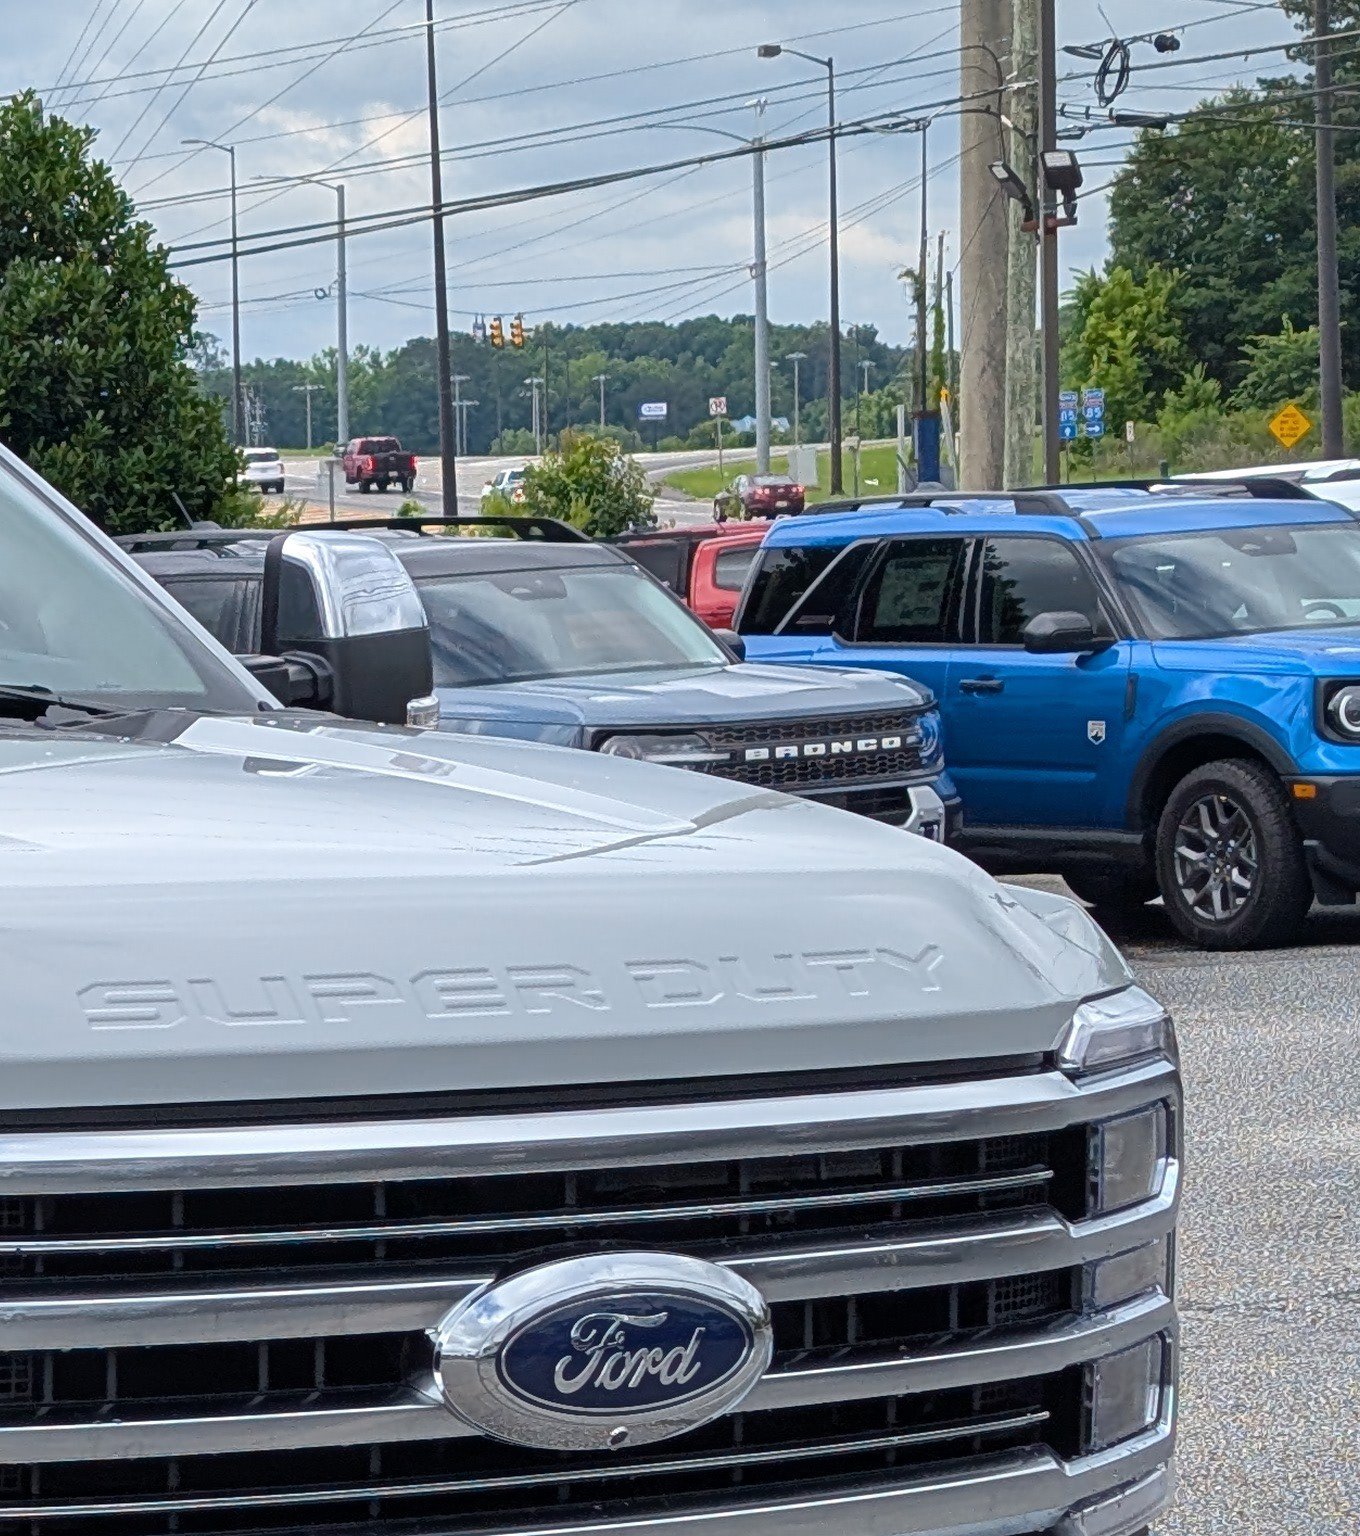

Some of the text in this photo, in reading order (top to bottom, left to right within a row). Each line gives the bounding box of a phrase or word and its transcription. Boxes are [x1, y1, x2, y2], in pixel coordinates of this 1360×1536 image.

[745, 736, 901, 761] BRONCO
[77, 944, 942, 1030] SUPER DUTY
[554, 1311, 706, 1394] Ford
